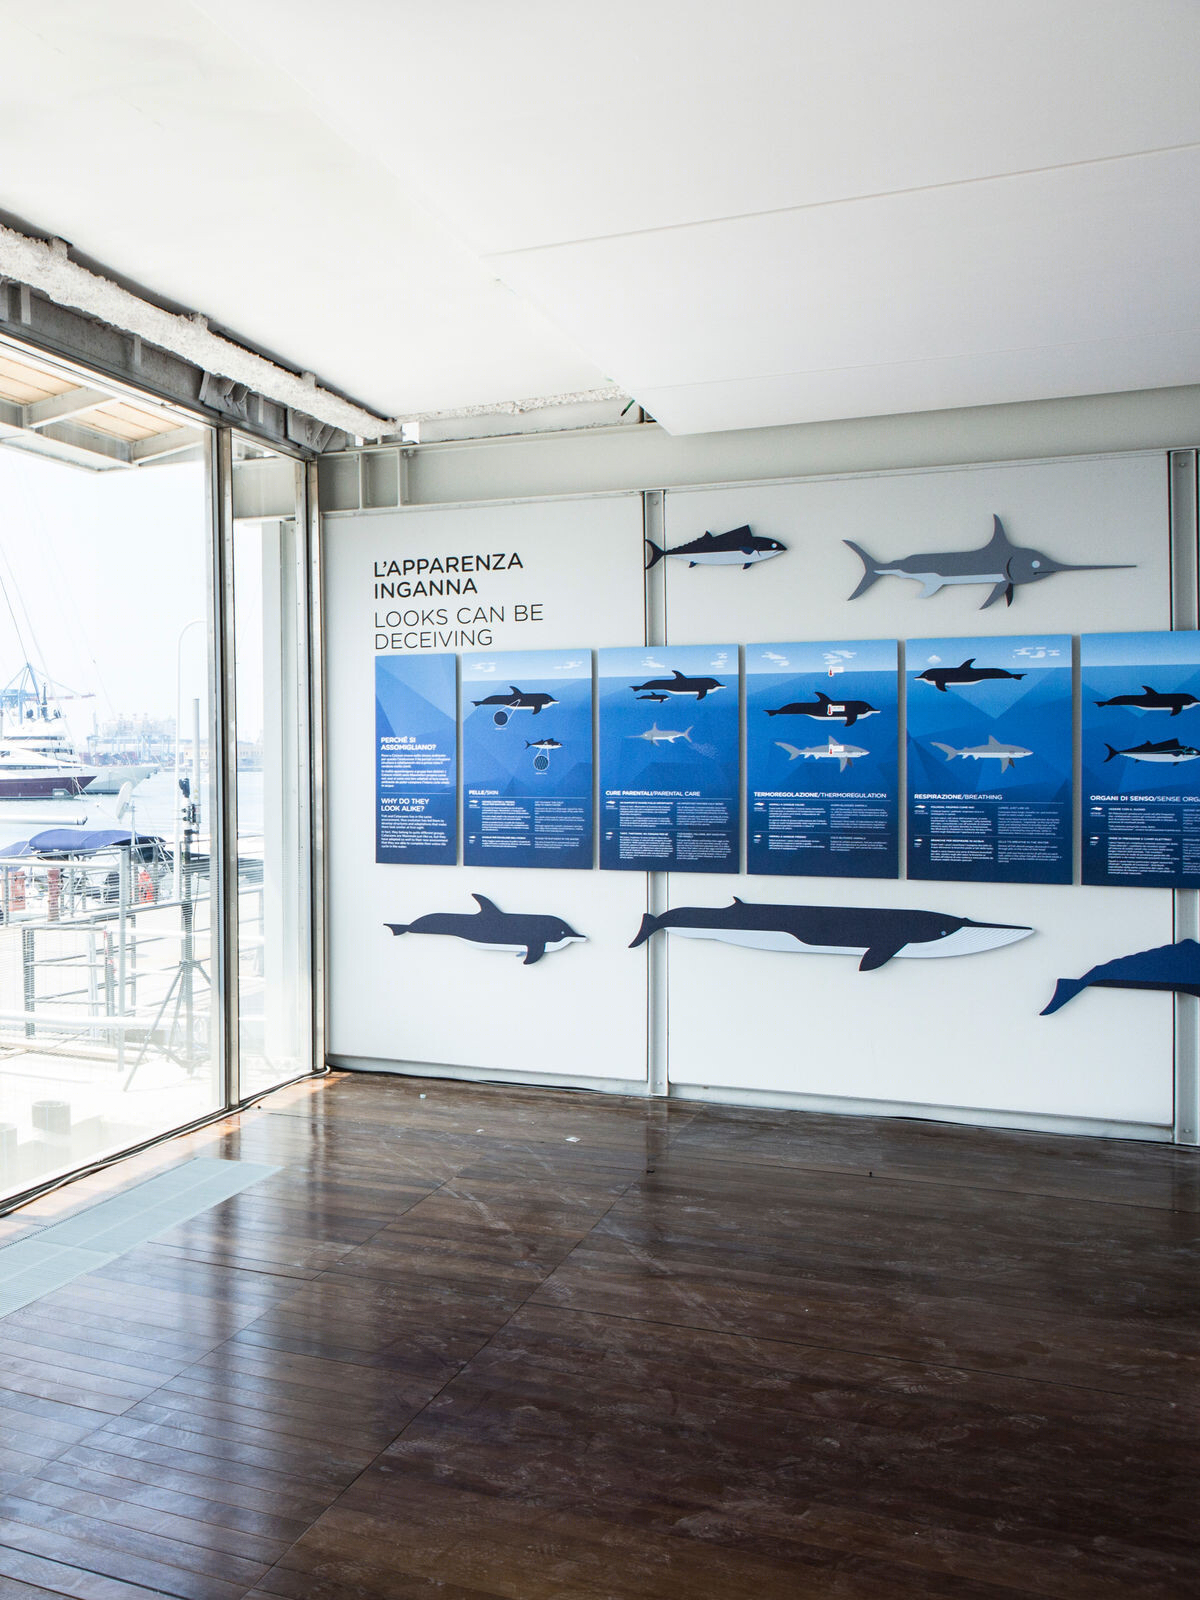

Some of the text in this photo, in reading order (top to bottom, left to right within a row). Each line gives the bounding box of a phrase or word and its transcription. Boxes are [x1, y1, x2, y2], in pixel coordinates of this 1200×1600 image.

[374, 578, 478, 599] INGANNA
[375, 603, 544, 628] LOOKS CAN BE
[375, 628, 493, 650] DECEIVING
[753, 791, 887, 799] TERMOREGOLAZIONE/THERMOREGULATION
